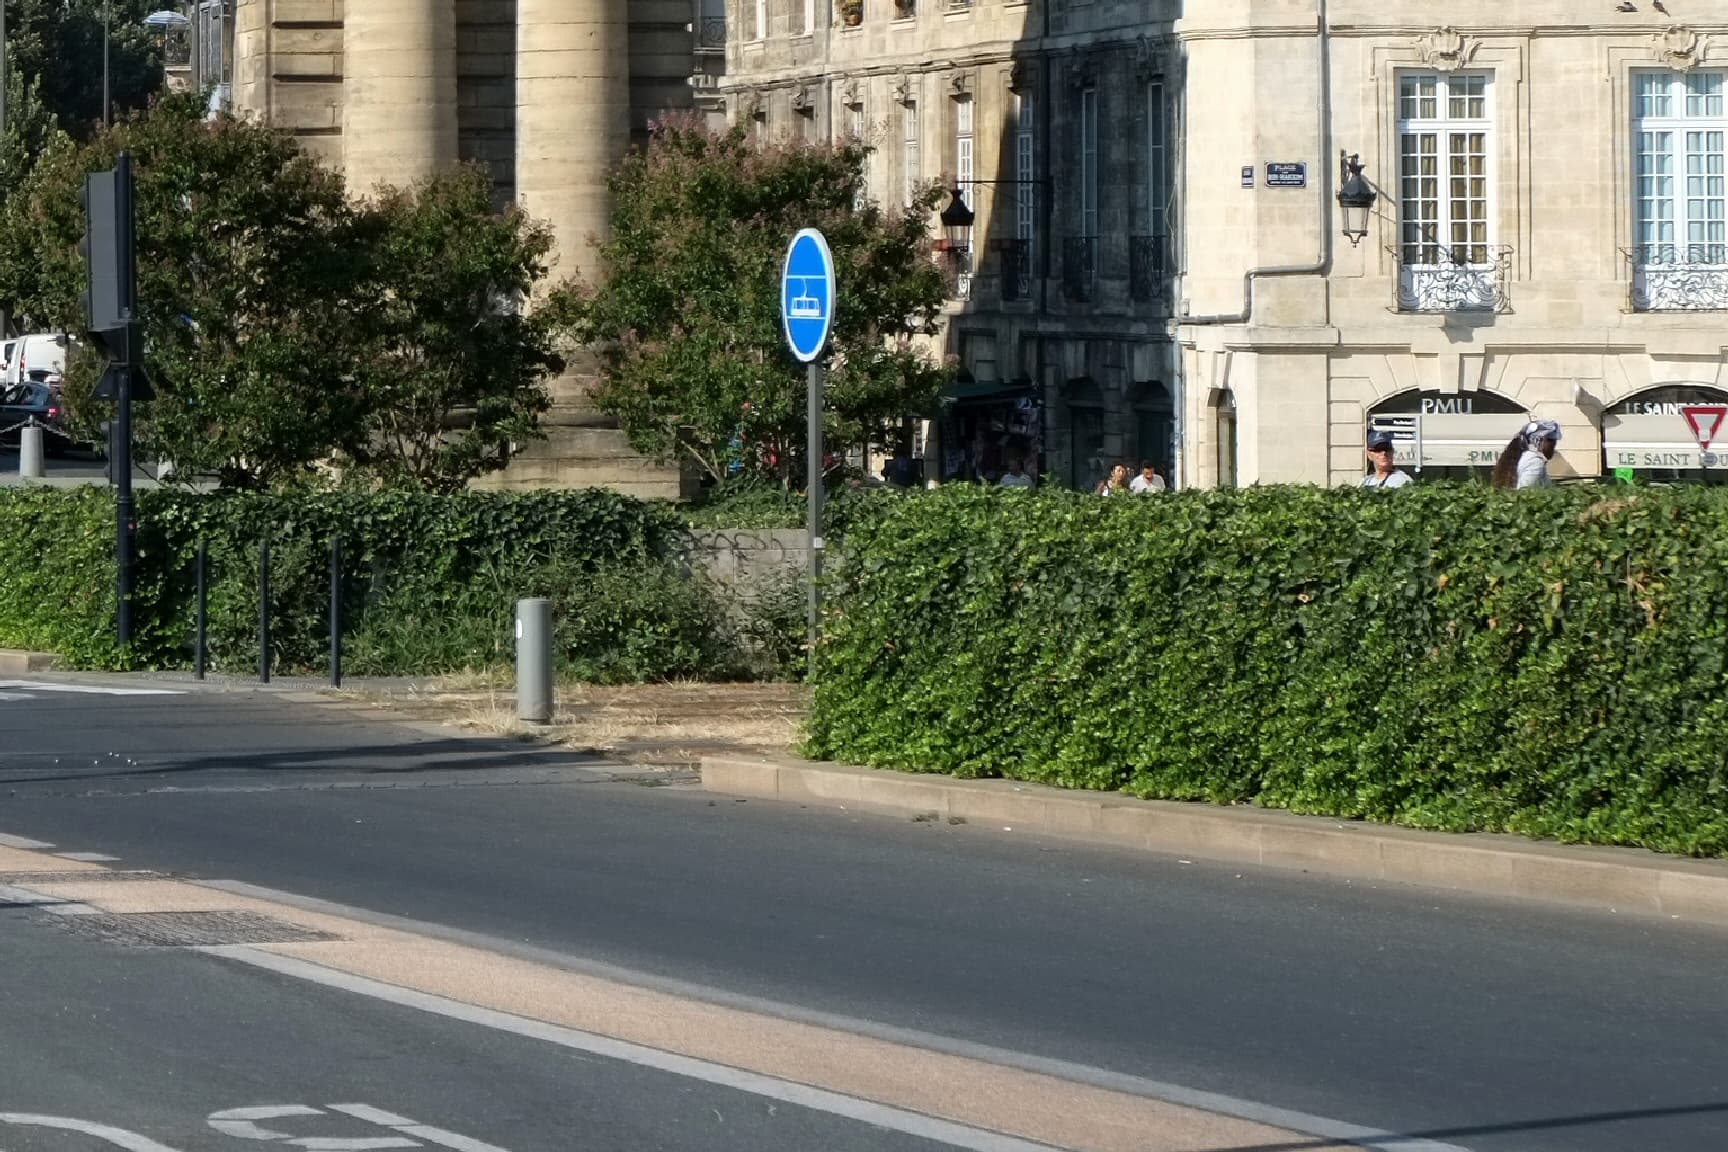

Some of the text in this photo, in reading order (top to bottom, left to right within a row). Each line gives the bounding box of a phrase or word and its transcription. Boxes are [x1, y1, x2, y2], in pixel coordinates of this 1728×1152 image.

[1422, 398, 1472, 414] PMU
[1618, 452, 1636, 465] LE
[1644, 452, 1690, 466] SAINT
